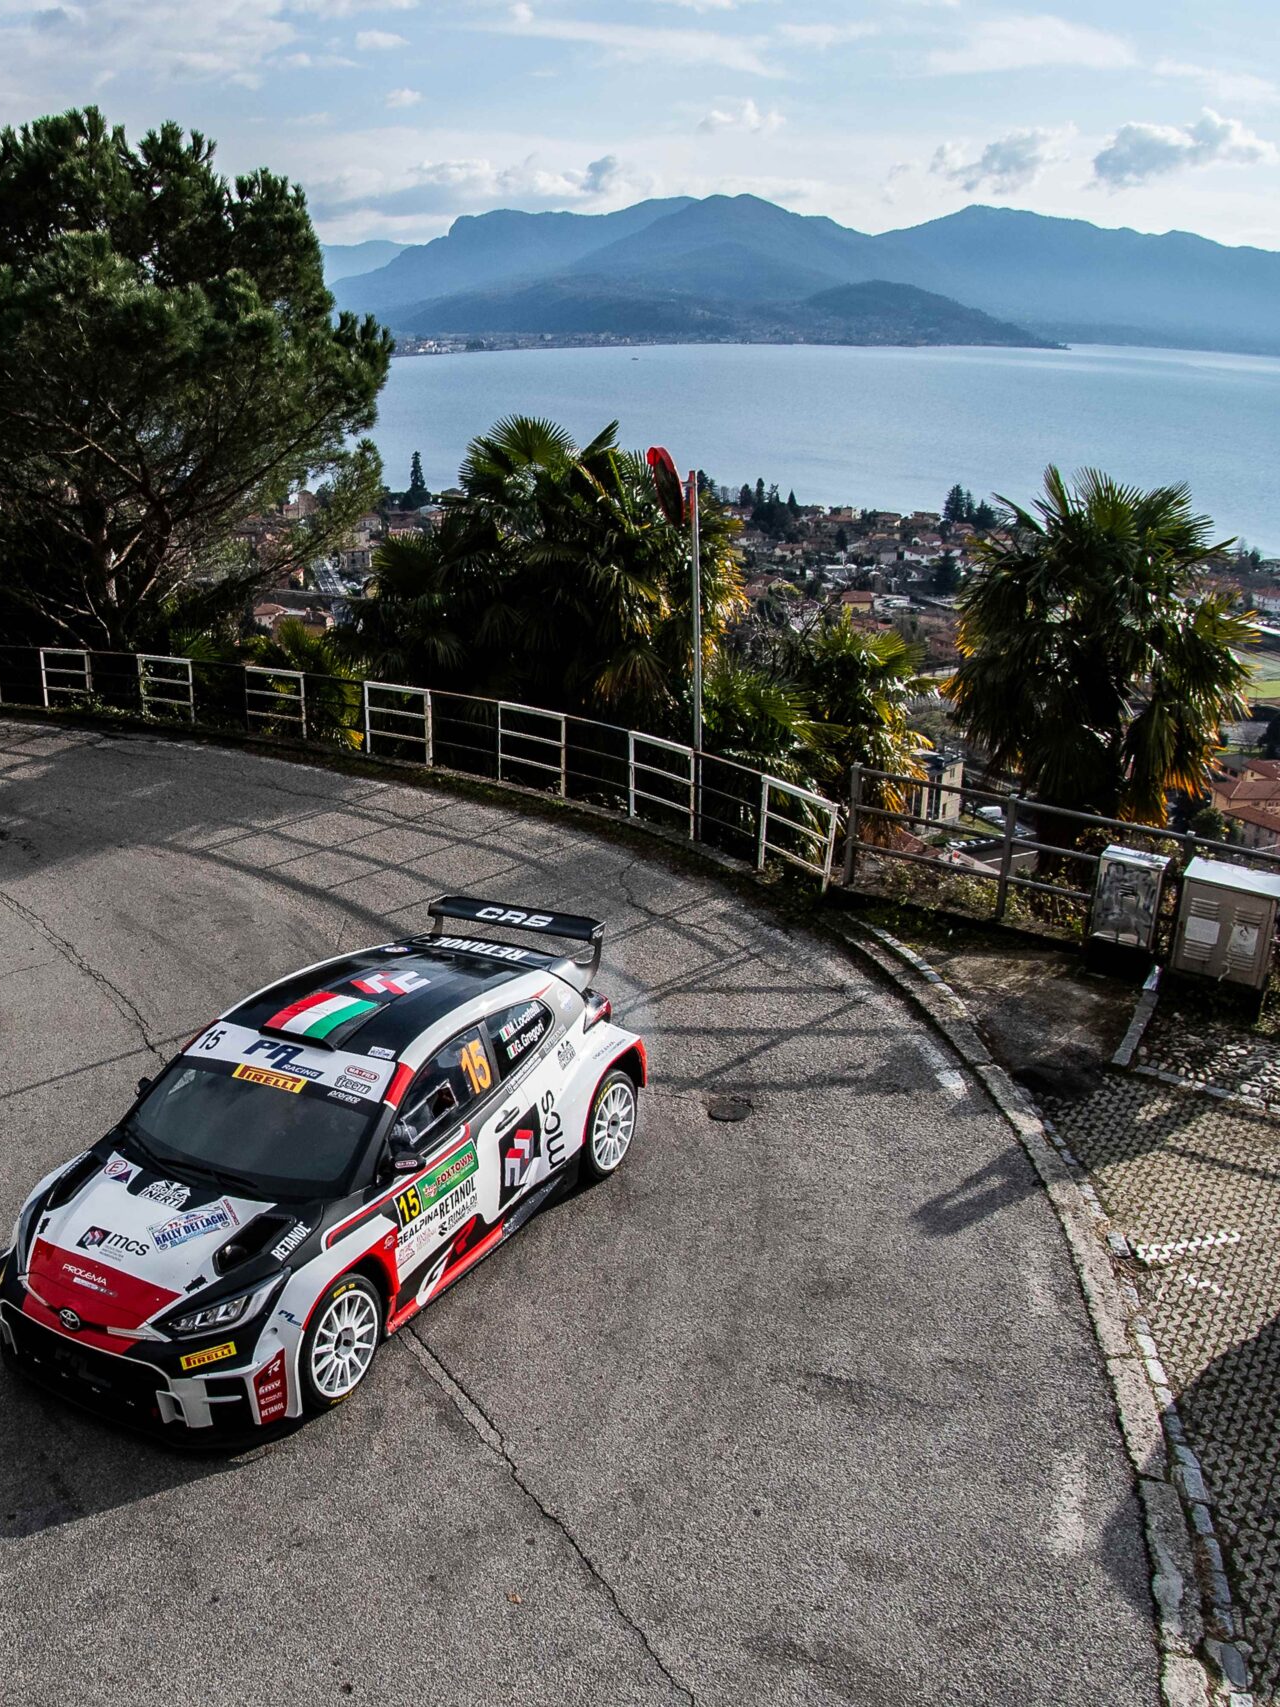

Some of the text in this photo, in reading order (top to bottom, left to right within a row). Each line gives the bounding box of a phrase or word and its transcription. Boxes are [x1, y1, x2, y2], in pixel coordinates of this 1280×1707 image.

[476, 907, 554, 928] CRS
[434, 936, 529, 961] RETANOL
[199, 1030, 226, 1050] 15
[521, 1018, 545, 1047] Gregori
[236, 1063, 301, 1091] PIRELLI
[282, 1063, 320, 1078] RACING
[460, 1039, 493, 1094] 15
[541, 1089, 566, 1170] mcs
[436, 1152, 474, 1185] FOXTOWN
[140, 1188, 184, 1208] INERTI
[399, 1187, 421, 1222] 15
[439, 1176, 477, 1220] RETANOL
[155, 1227, 183, 1246] RALLY
[183, 1221, 201, 1234] DEI
[200, 1212, 229, 1229] LAGHI
[270, 1221, 311, 1261] RETANOL
[398, 1207, 439, 1247] REALPINA
[107, 1233, 151, 1257] mcs
[184, 1344, 233, 1367] PIRELLI
